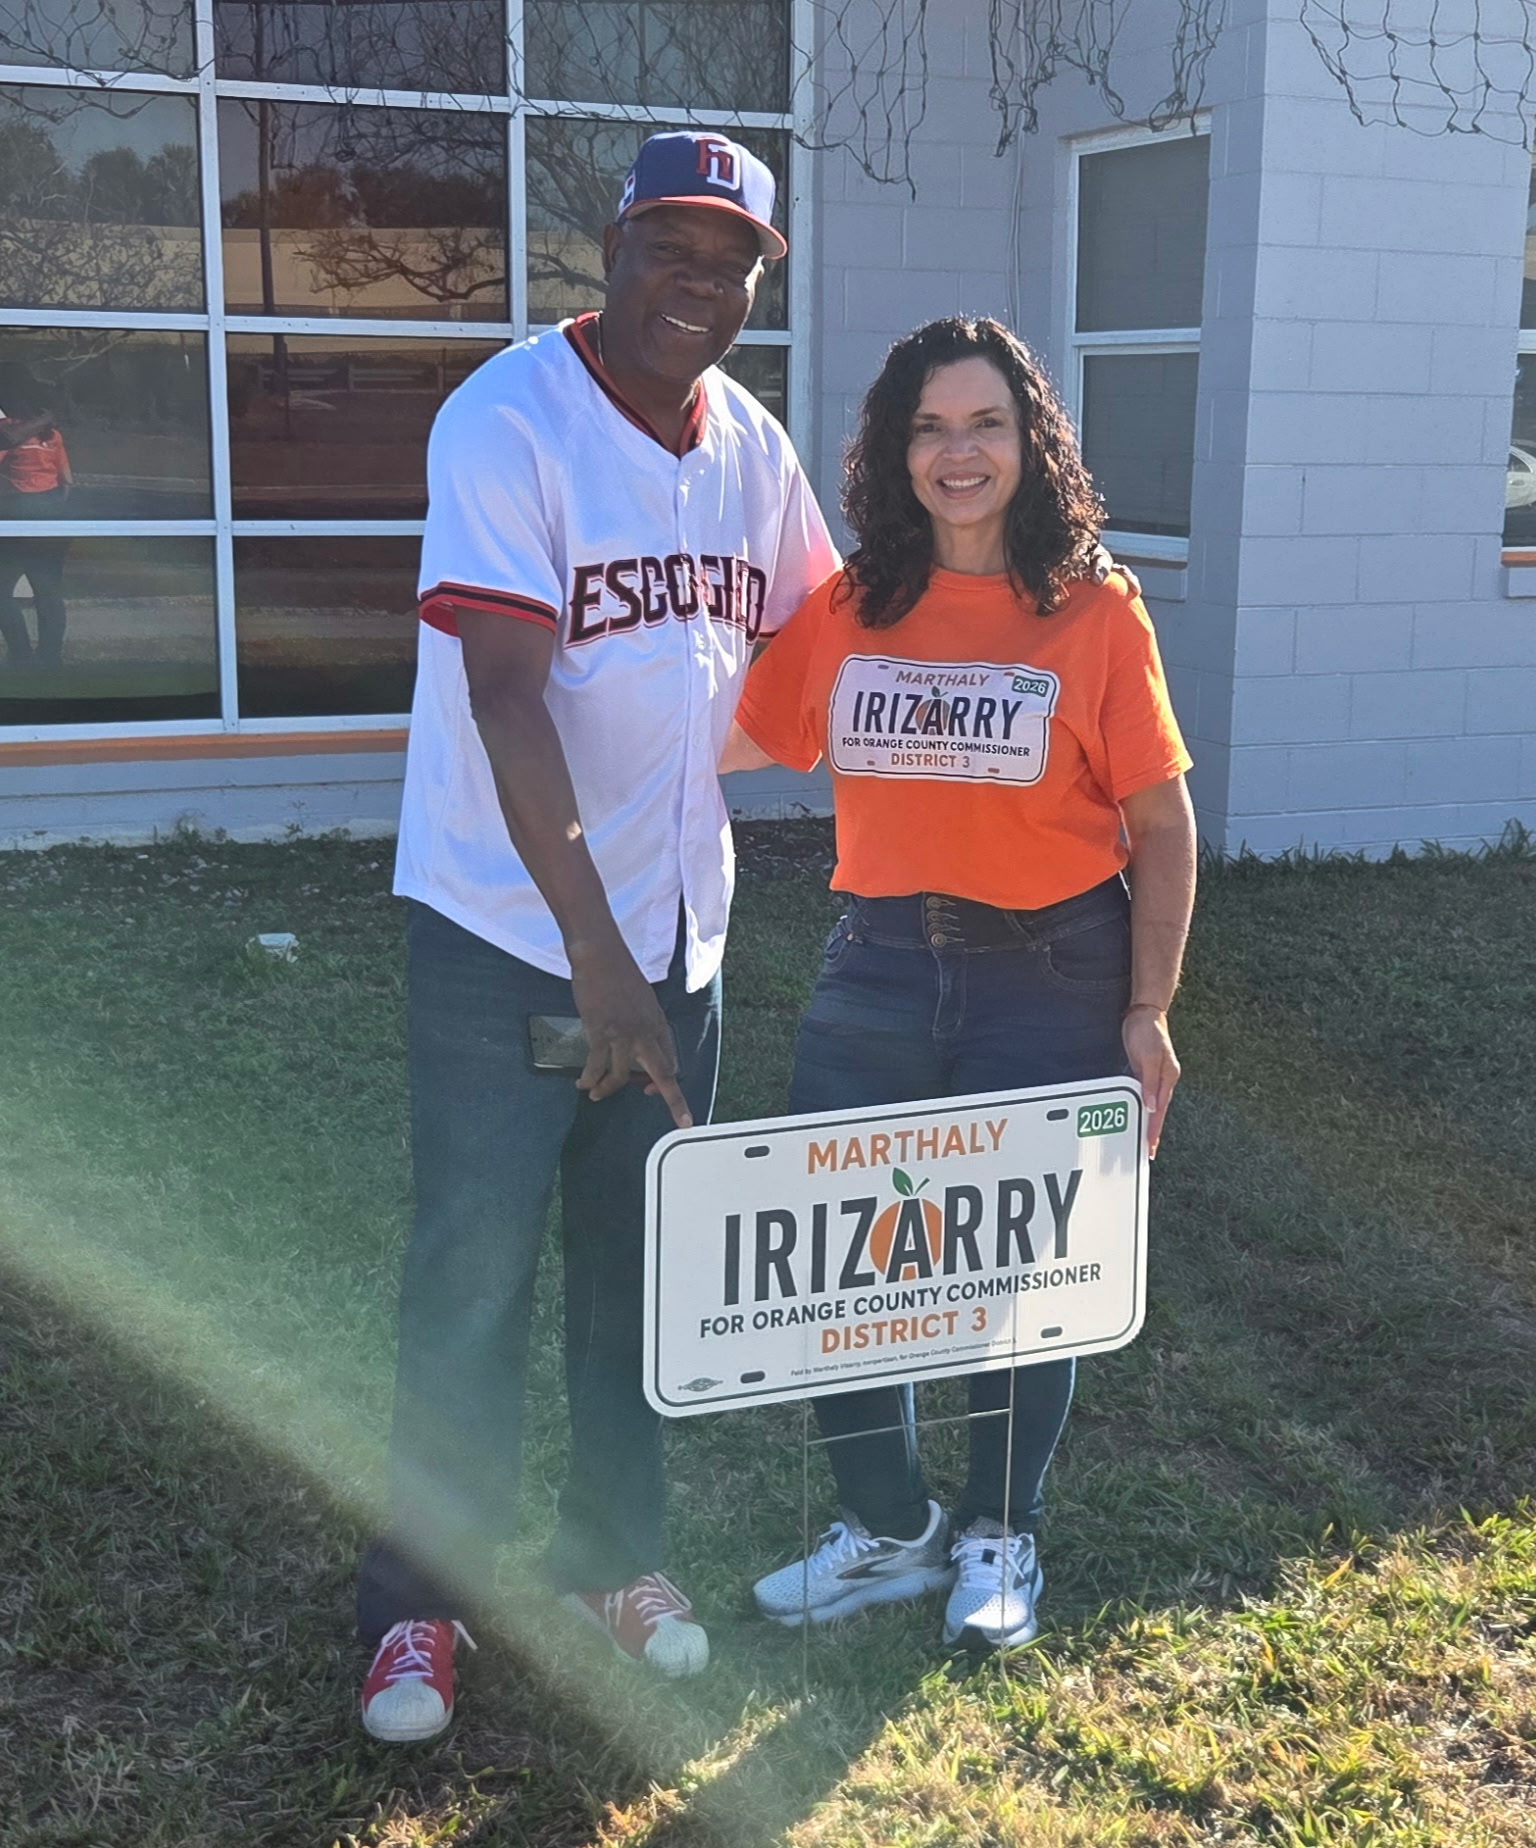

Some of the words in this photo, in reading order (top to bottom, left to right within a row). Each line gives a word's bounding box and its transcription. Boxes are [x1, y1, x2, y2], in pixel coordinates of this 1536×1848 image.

[895, 670, 991, 687] MARTHALY
[1013, 678, 1049, 695] 2026
[852, 691, 1023, 740] IRIZARRY
[842, 737, 861, 747] FOR
[863, 737, 904, 749] ORANGE
[906, 739, 949, 751] COUNTY
[950, 742, 1031, 757] COMMISSIONER
[891, 753, 957, 768] DISTRICT
[962, 756, 971, 769] 3
[1079, 1107, 1126, 1134] 2026
[807, 1118, 1009, 1175] MARTHALY
[724, 1169, 1083, 1306] IRIZARRY
[699, 1314, 745, 1338] FOR
[752, 1299, 847, 1331] ORANGE
[854, 1286, 944, 1315] COUNTY
[946, 1262, 1102, 1303] COMMISSIONER
[821, 1310, 958, 1354] DISTRICT
[970, 1306, 988, 1332] 3
